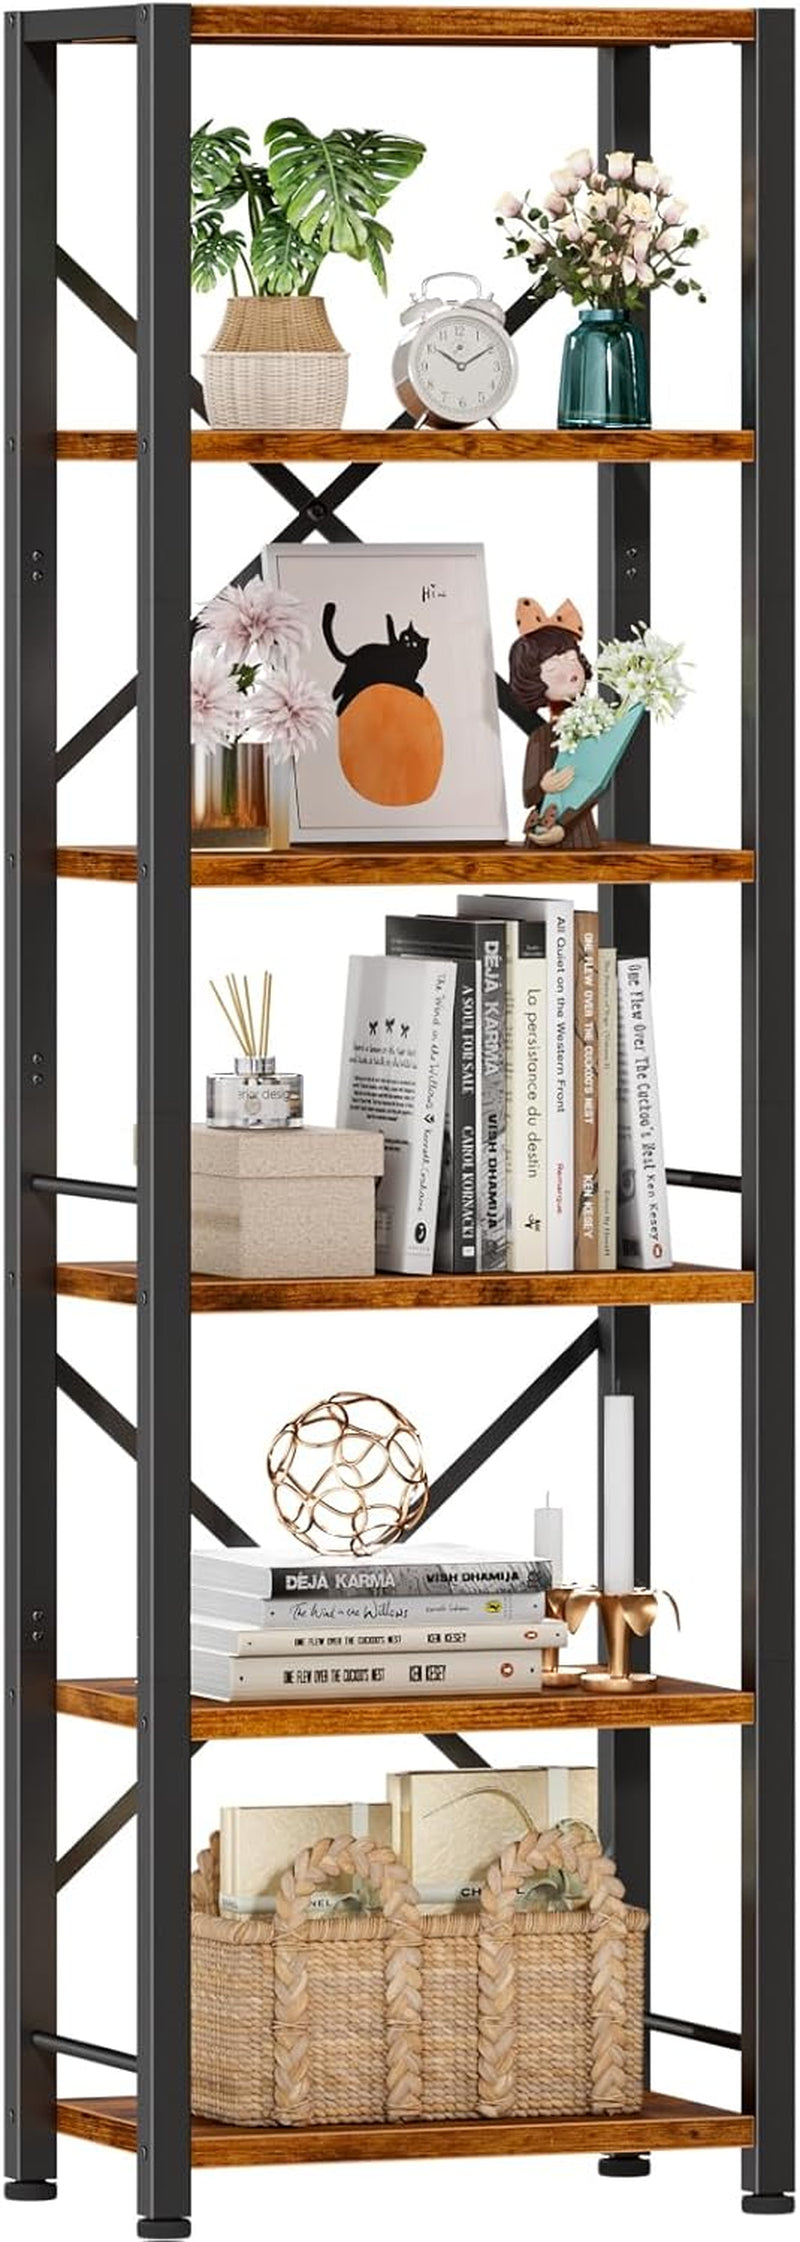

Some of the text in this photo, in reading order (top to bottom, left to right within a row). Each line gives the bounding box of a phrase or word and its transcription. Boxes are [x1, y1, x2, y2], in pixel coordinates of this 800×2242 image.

[584, 932, 594, 952] ONE
[584, 955, 594, 986] FLEW
[555, 916, 567, 1113] All Quiet on the Western Front
[584, 990, 594, 1017] OVER
[461, 985, 475, 1094] A SOUL FOR SALE
[484, 1001, 501, 1077] KARMA
[584, 1021, 594, 1042] THE
[628, 964, 656, 1170] One Flew Over The Cuckoo's Nest
[524, 988, 542, 1179] La persistance du destin
[583, 1097, 595, 1125] NEST
[461, 1126, 475, 1169] CAROL
[487, 1113, 499, 1229] VISH DHAMIJA
[555, 1163, 565, 1215] Remarque
[583, 1174, 595, 1239] KEN KESEY
[645, 1173, 659, 1241] Ken Kesey
[335, 1573, 395, 1591] KARMA
[426, 1571, 520, 1583] VISH DHAMIJA
[363, 1599, 409, 1619] Willows
[427, 1632, 466, 1643] KEN KESEY
[283, 1670, 294, 1684] ONE
[296, 1669, 312, 1684] FLEW
[313, 1669, 328, 1683] OVER
[330, 1668, 341, 1683] THE
[371, 1667, 385, 1682] NEST
[409, 1664, 447, 1682] KEN KESEY
